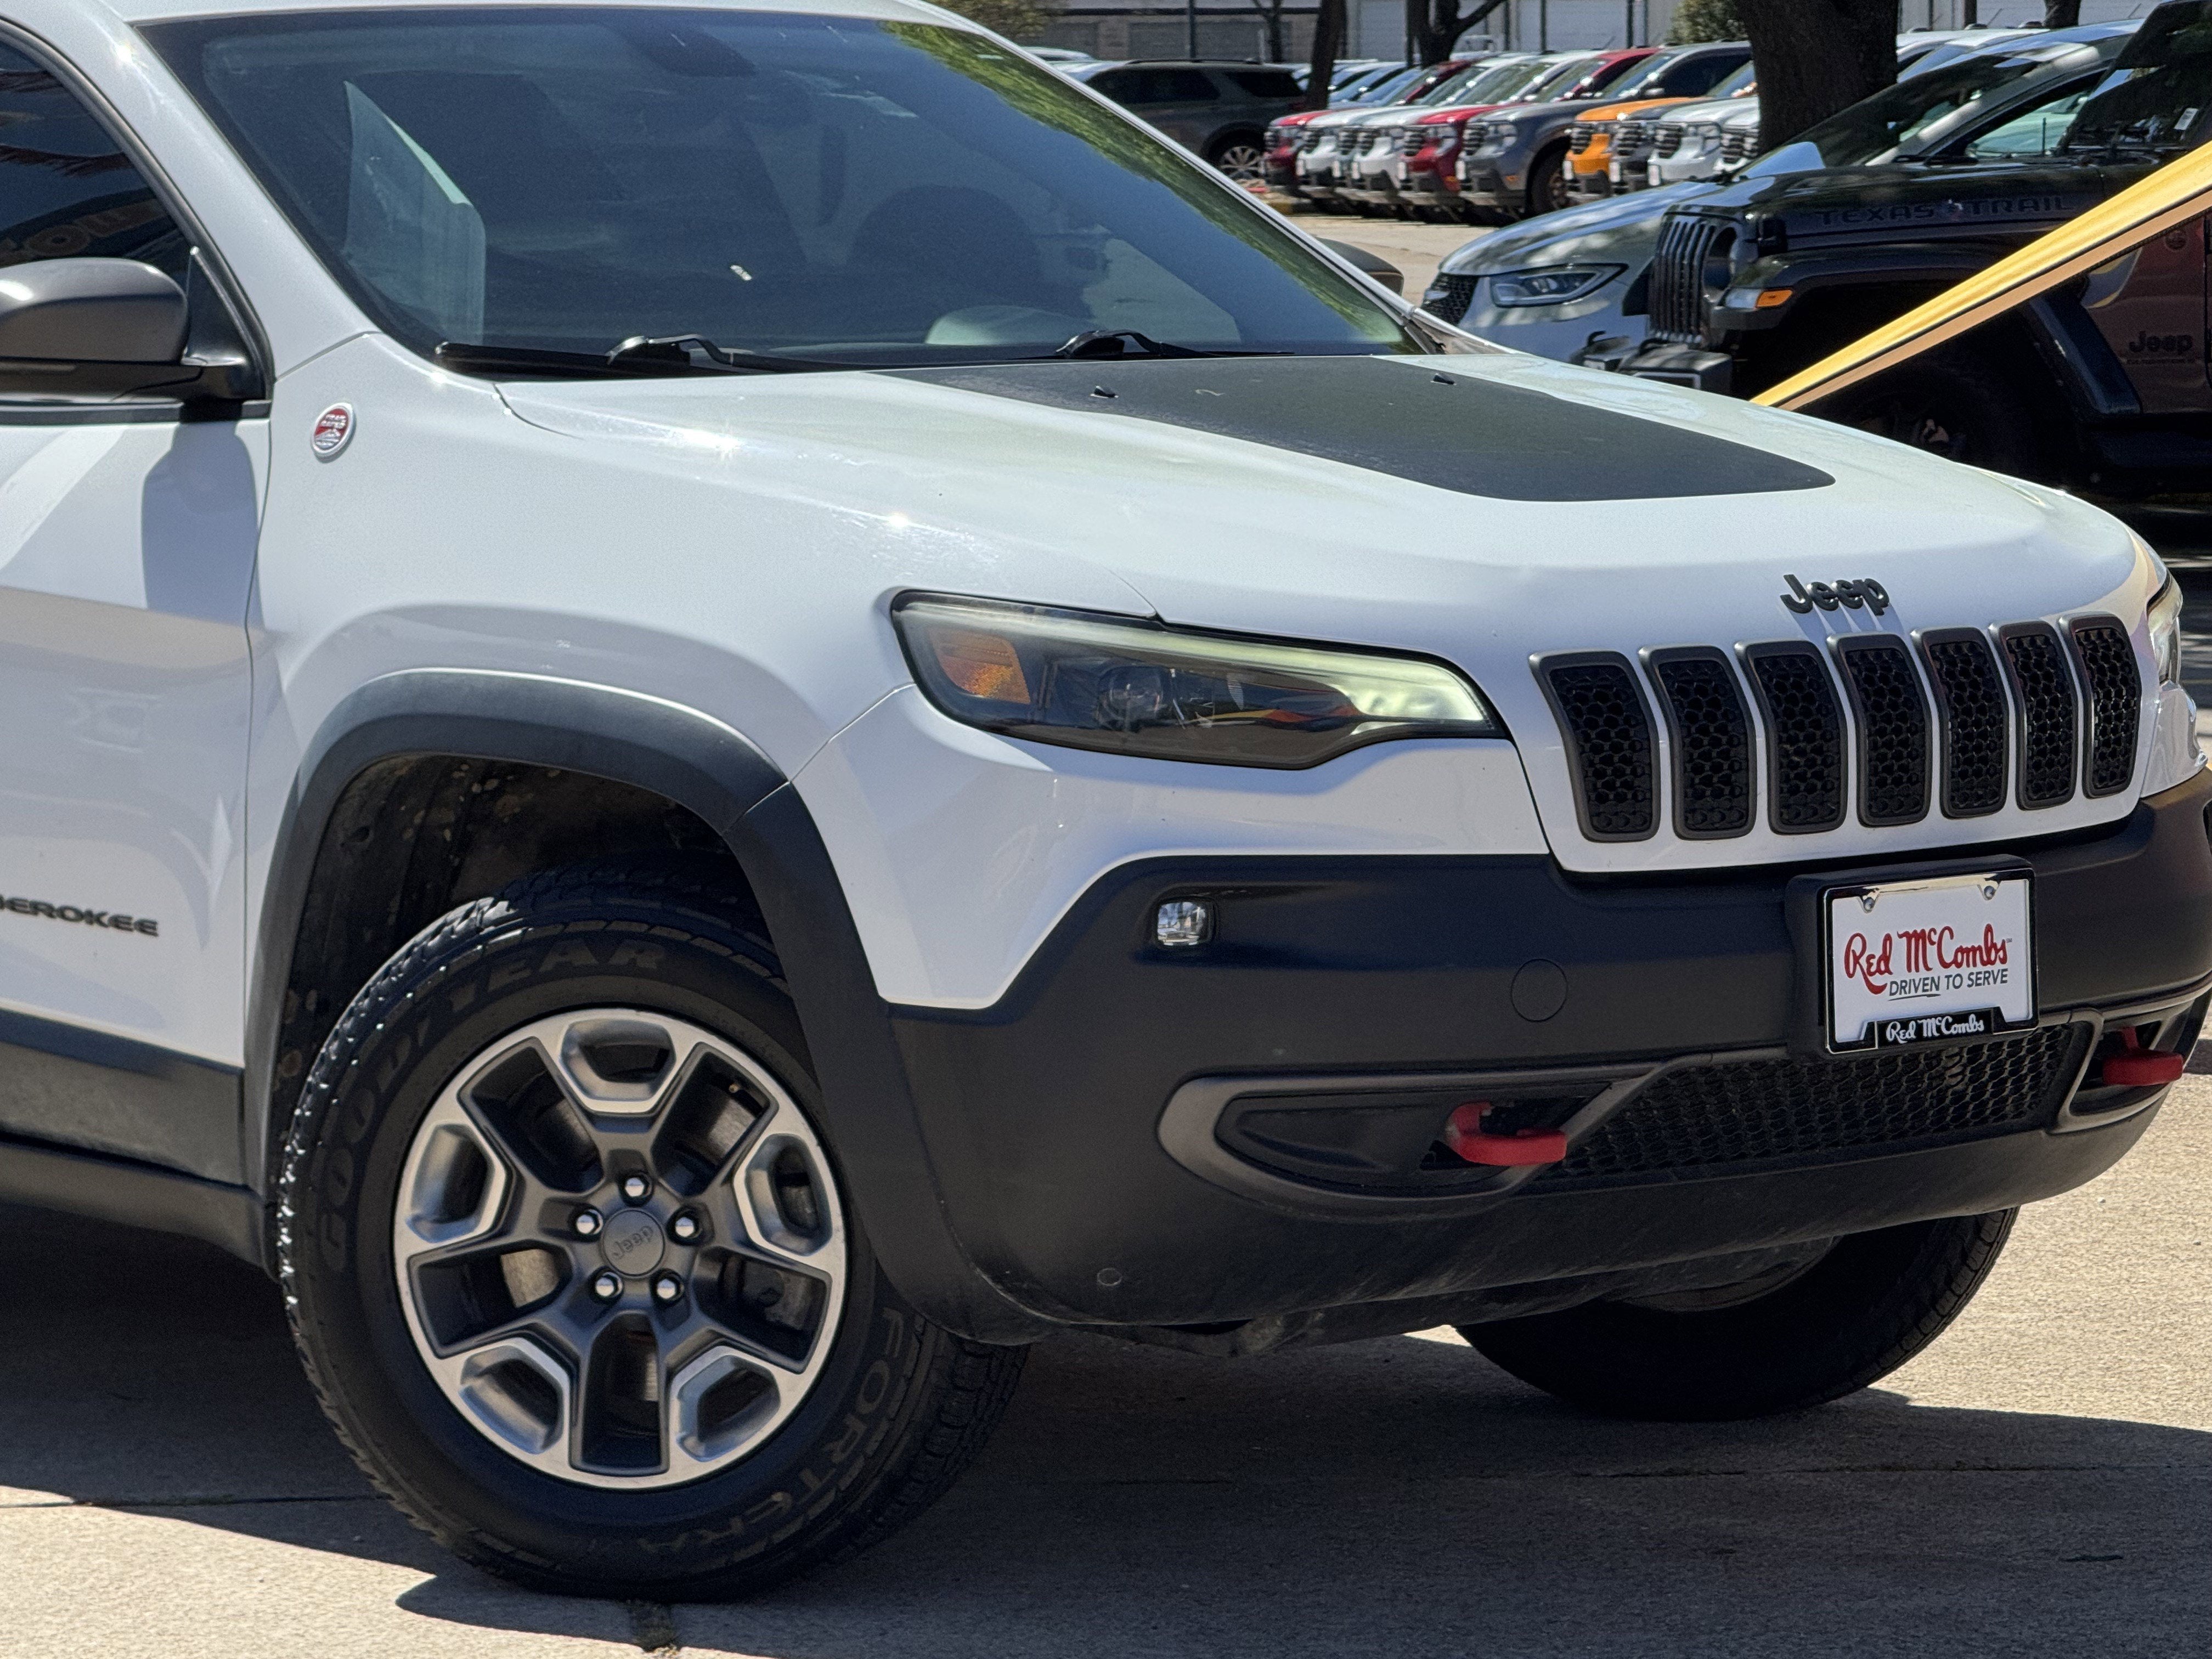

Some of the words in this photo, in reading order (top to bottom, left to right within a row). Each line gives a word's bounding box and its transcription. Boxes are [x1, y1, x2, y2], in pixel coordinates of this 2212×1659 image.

[1815, 202, 1934, 225] TEXAS
[1961, 194, 2075, 216] TRAIL
[2129, 330, 2193, 355] Jeep
[1780, 574, 1889, 616] Jeep
[0, 894, 159, 937] EROKEE
[1844, 932, 1893, 995] Red
[1897, 923, 2008, 973] McCombs
[1889, 975, 1940, 996] DRIVEN
[1944, 973, 1963, 989] TO
[1966, 968, 2008, 988] SERVE
[1886, 1020, 1917, 1043] Red
[1917, 1013, 1985, 1037] McCombs
[612, 1225, 654, 1260] Jeep
